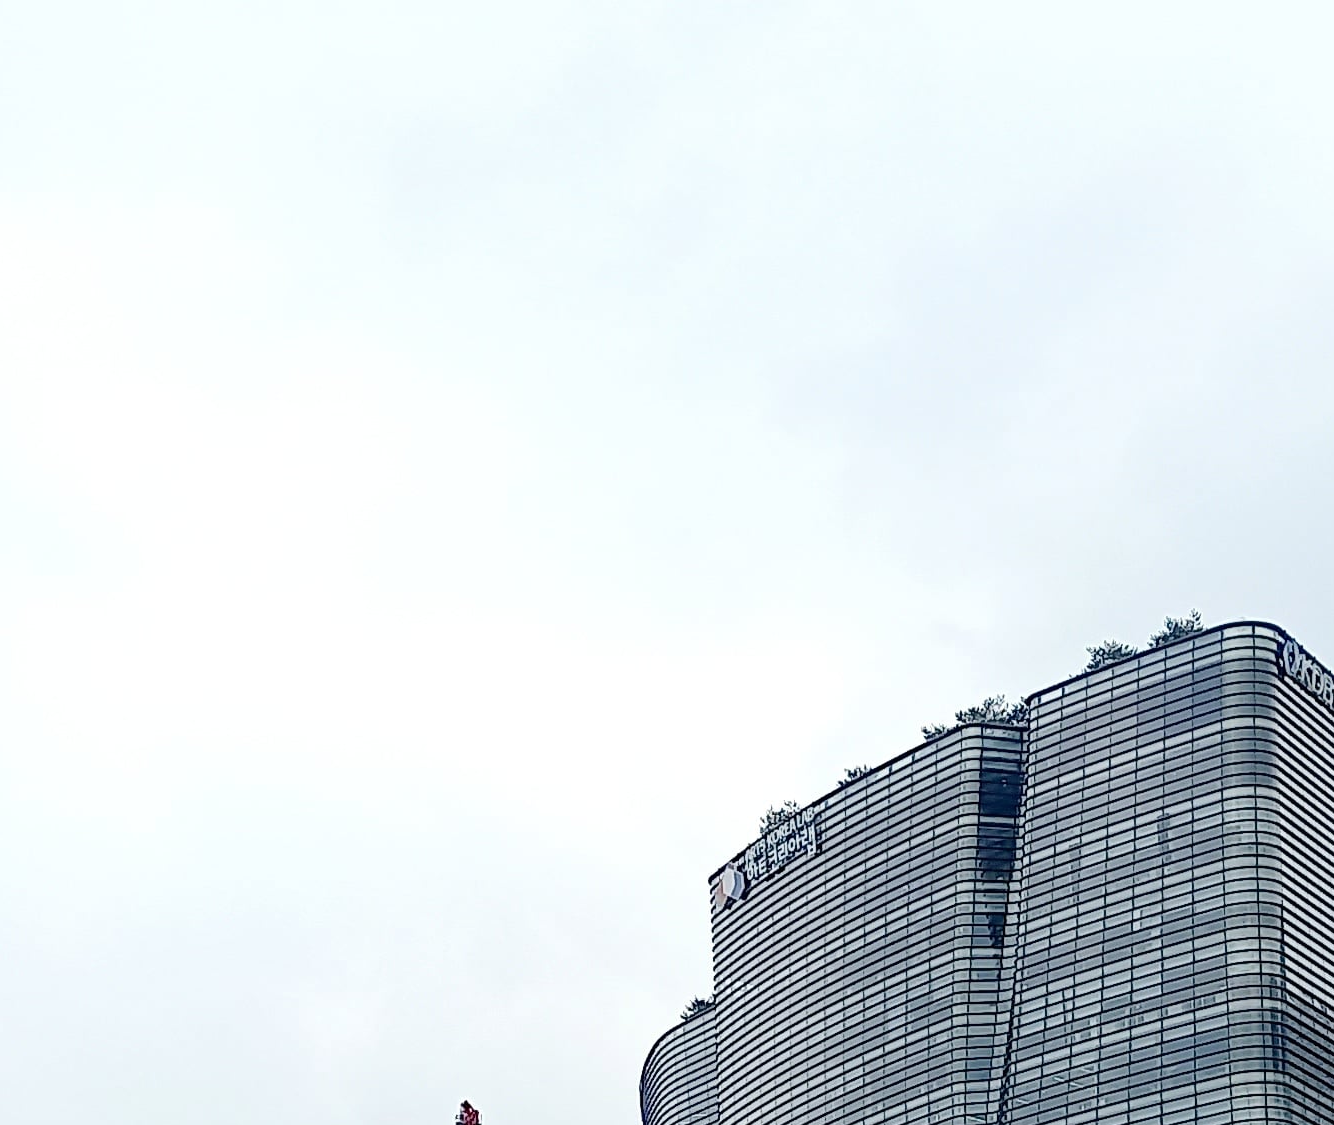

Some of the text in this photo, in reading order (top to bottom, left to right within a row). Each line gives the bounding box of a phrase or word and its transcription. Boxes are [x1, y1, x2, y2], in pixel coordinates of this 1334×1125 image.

[747, 822, 817, 880] 아트코리아랩
[766, 817, 797, 850] KOREA
[795, 808, 816, 829] LAB
